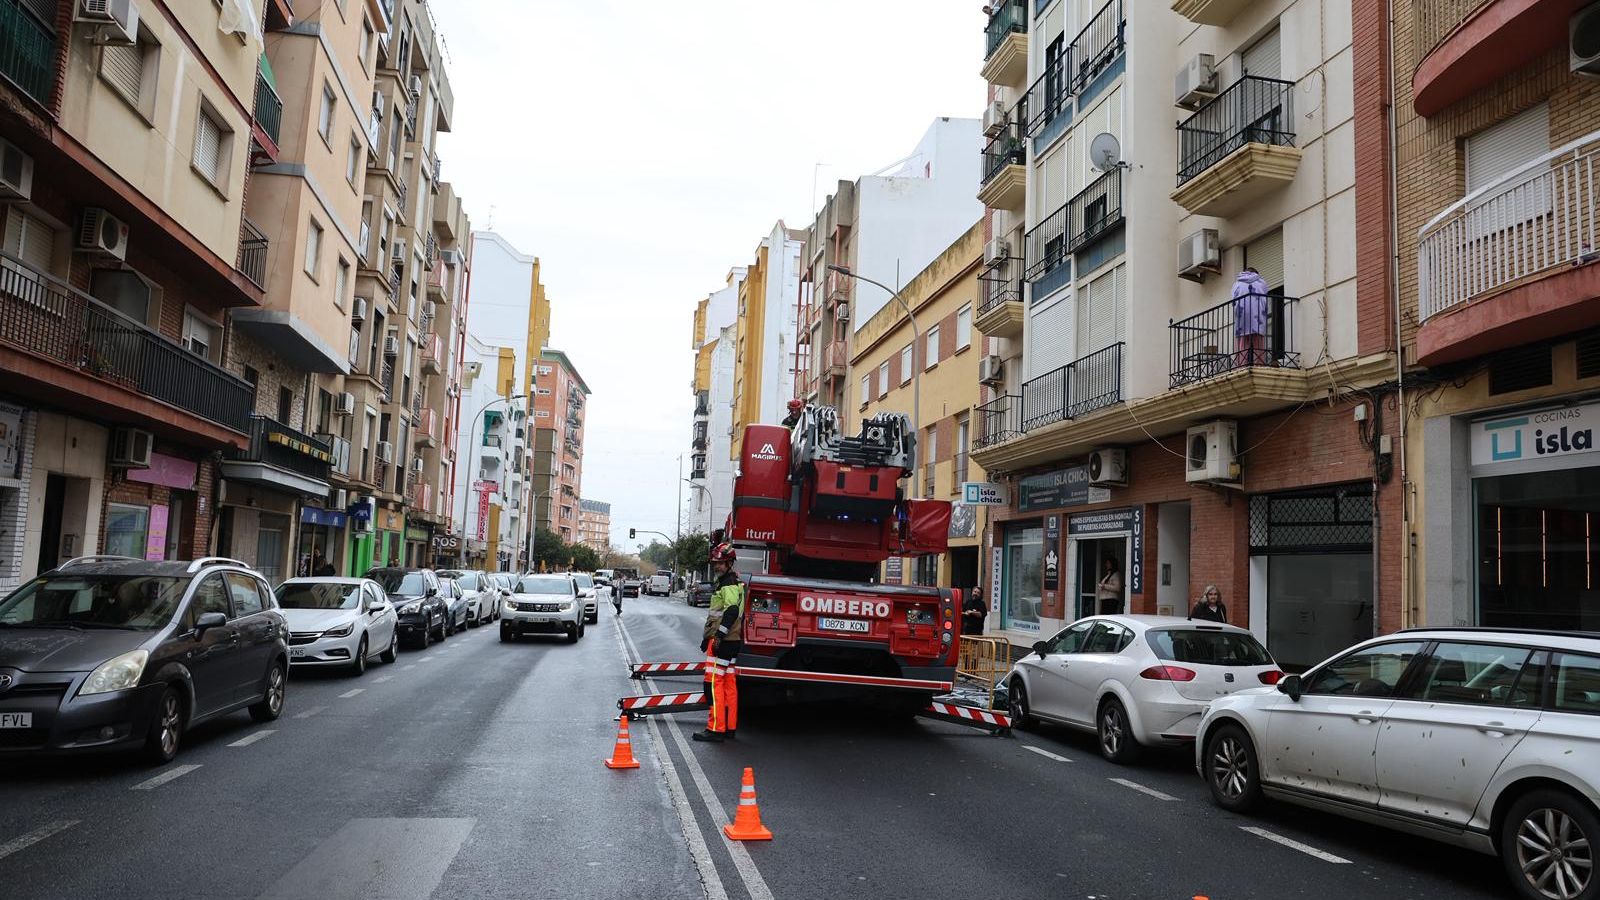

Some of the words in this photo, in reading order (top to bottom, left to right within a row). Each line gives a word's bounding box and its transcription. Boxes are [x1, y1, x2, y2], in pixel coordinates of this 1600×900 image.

[1535, 409, 1581, 424] COCINAS
[1535, 426, 1593, 455] isla
[751, 453, 782, 461] MAGIRUS
[1054, 472, 1067, 486] ISLA
[1067, 469, 1088, 484] CHICA
[980, 488, 996, 496] isla
[746, 529, 776, 540] iturri
[801, 596, 890, 618] OMBERO
[825, 619, 845, 629] 0878
[850, 621, 866, 631] KCN
[2, 714, 28, 727] FVL
